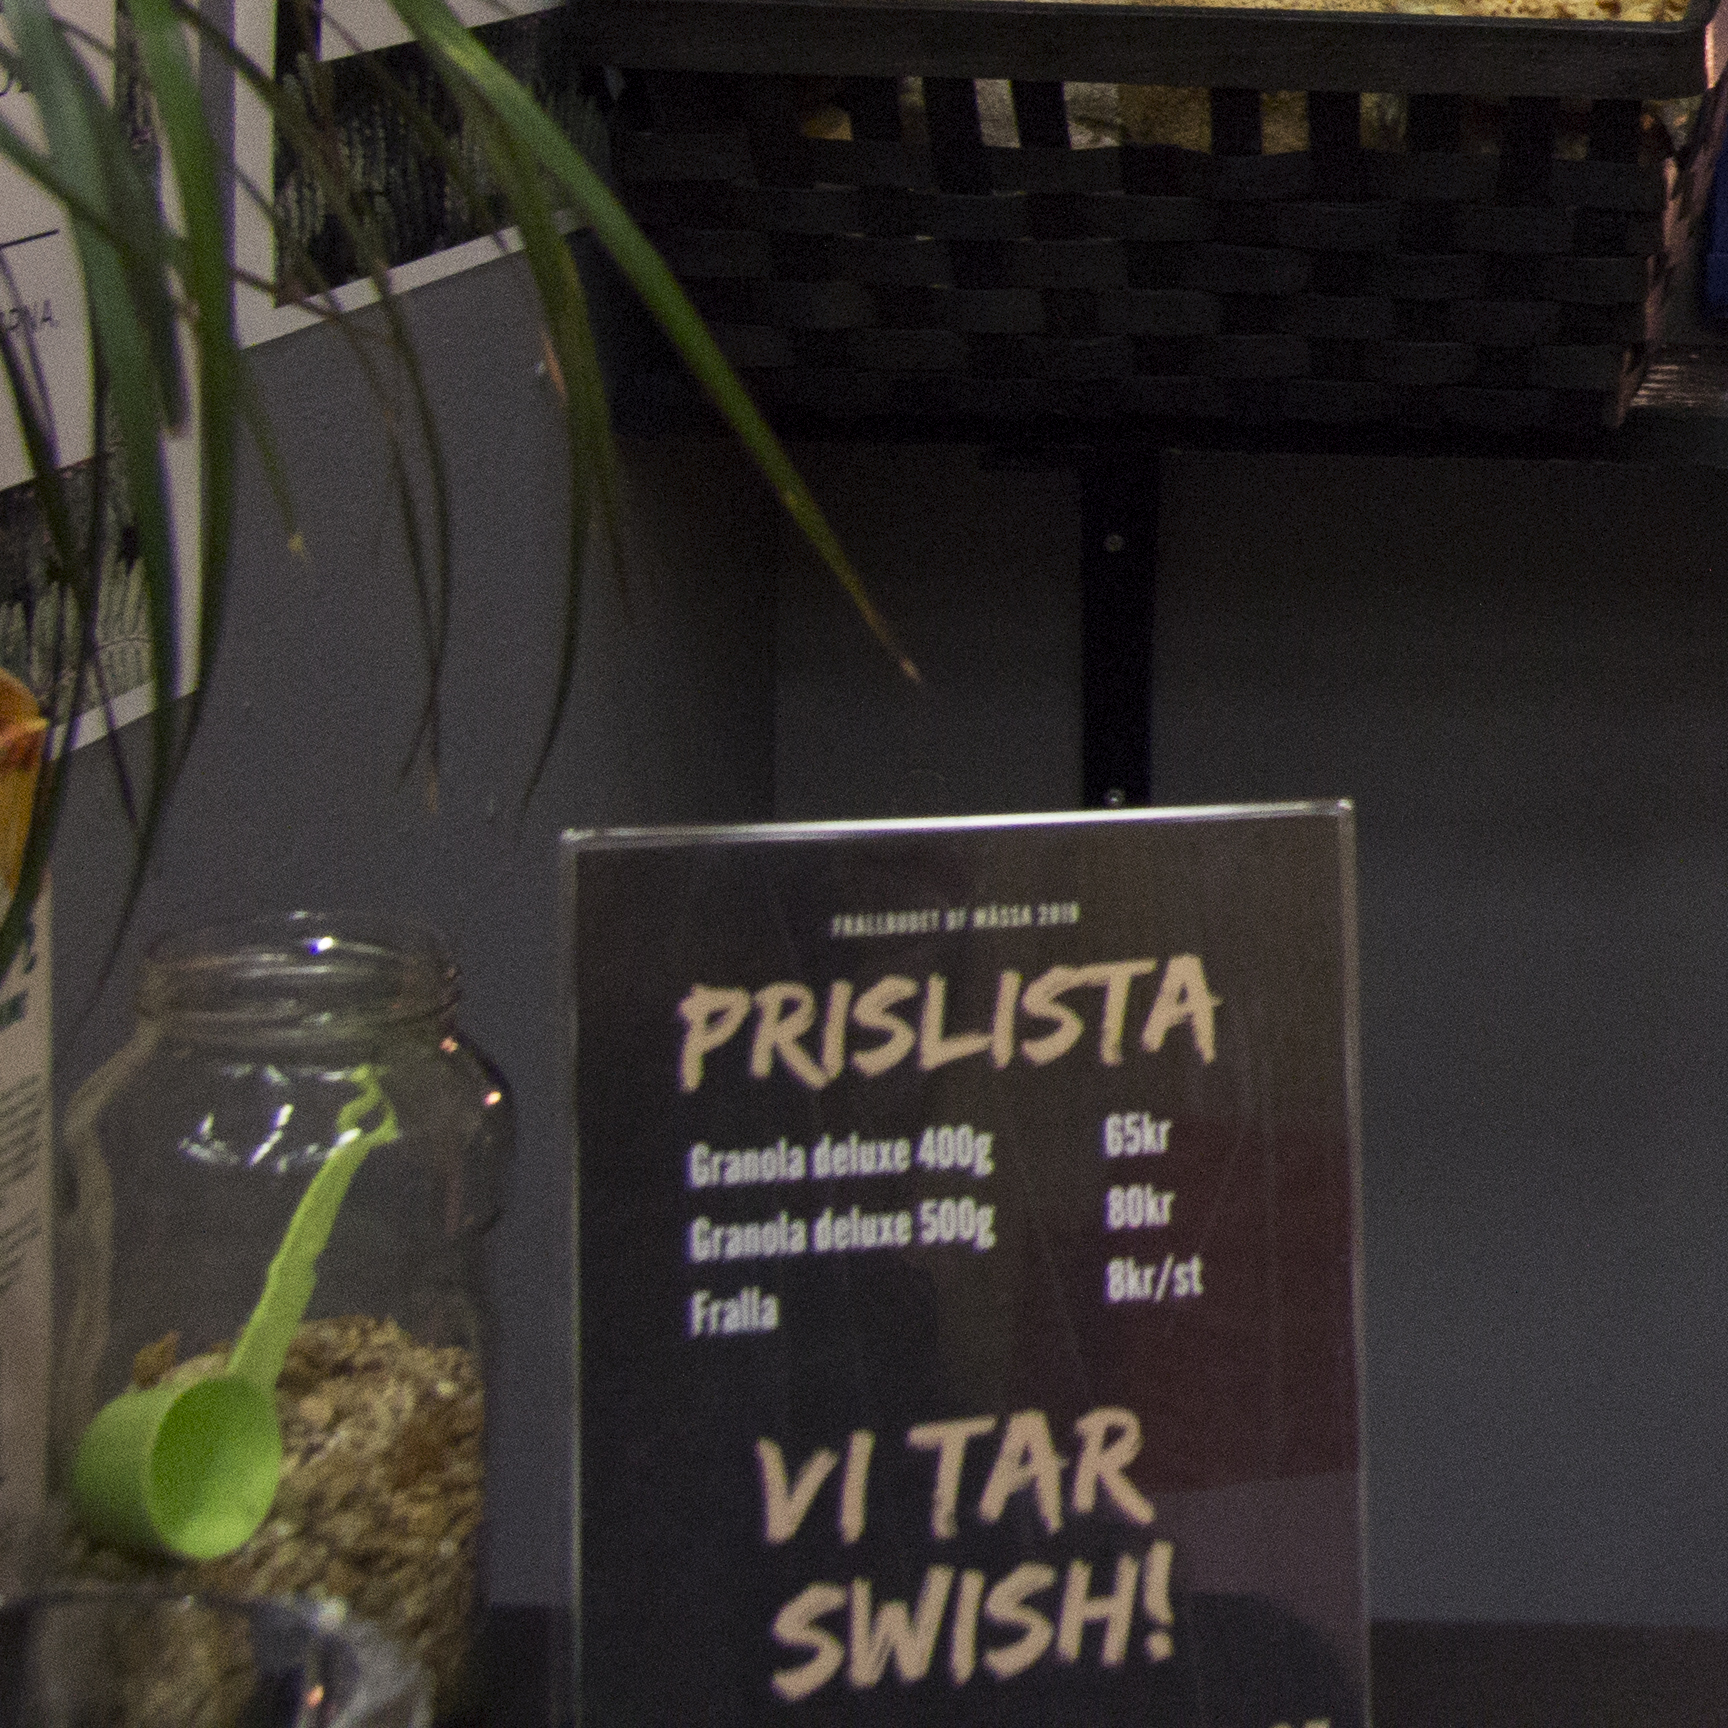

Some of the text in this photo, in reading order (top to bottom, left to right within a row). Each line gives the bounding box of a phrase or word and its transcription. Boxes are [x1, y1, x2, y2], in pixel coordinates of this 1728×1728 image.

[831, 909, 940, 939] FRALLBUDET
[677, 952, 1222, 1094] PRISLISTA
[688, 1123, 994, 1190] Granola deluxe 400g
[1104, 1112, 1173, 1158] 65kr
[688, 1197, 996, 1263] Granola deluxe 500g
[1105, 1185, 1175, 1230] 80kr
[1105, 1255, 1203, 1302] 8kr/st
[688, 1285, 780, 1338] Fralla
[753, 1406, 1156, 1544] VI TAR
[771, 1540, 1176, 1701] SWISH!
